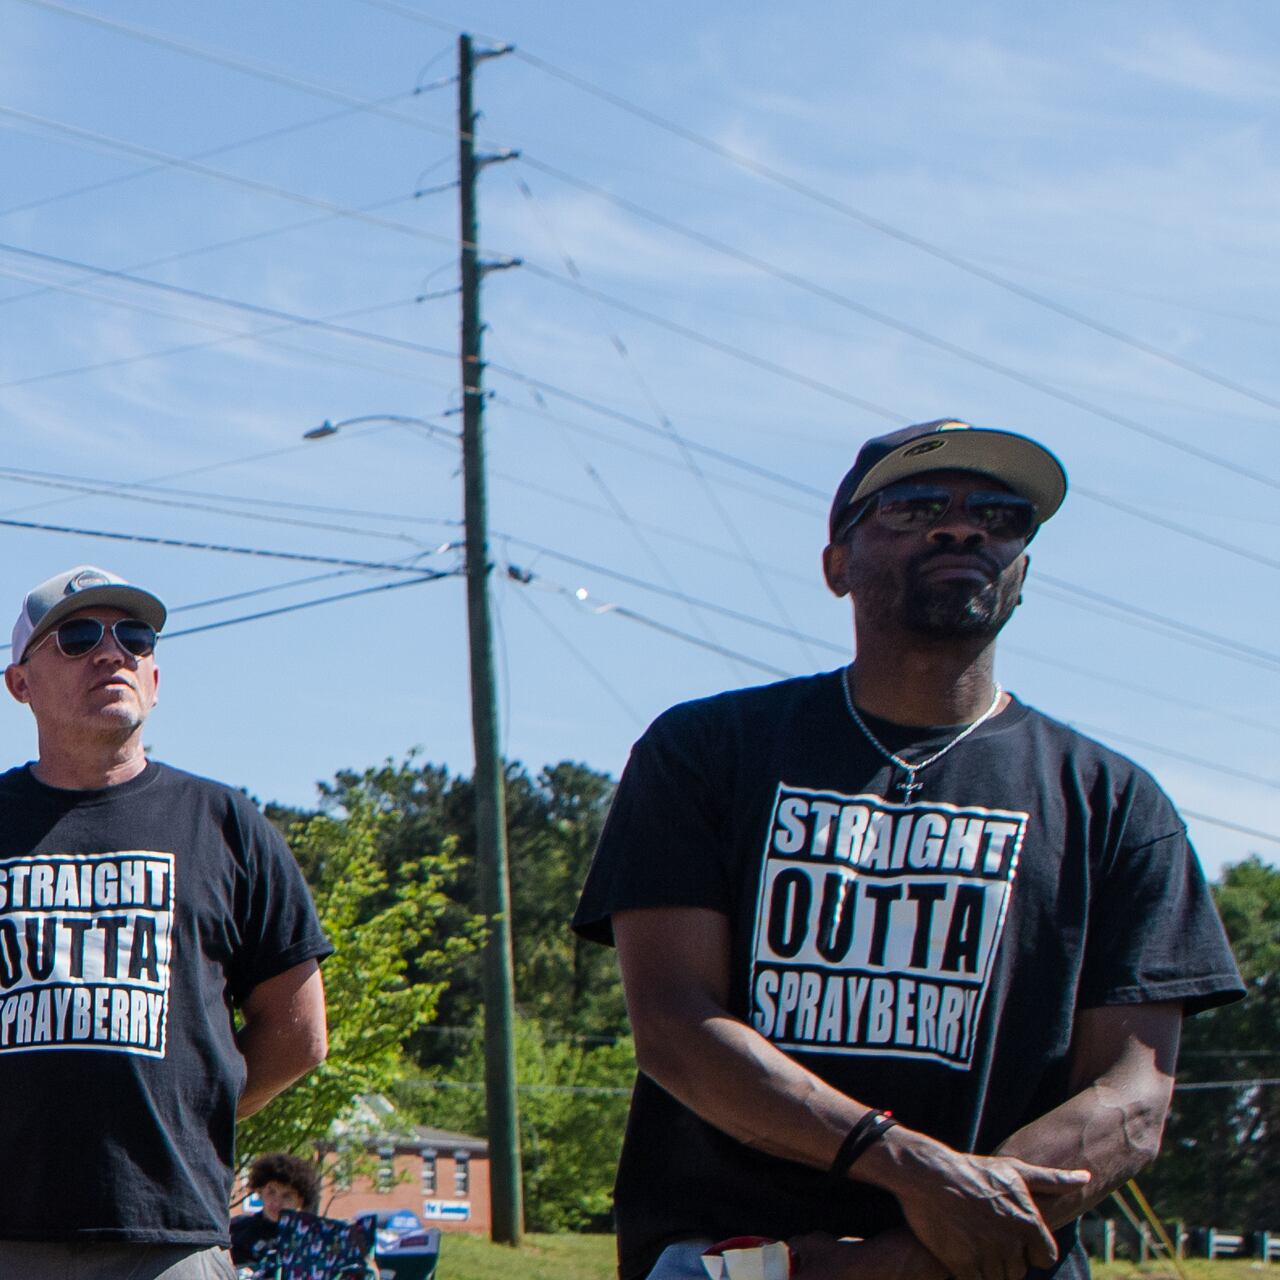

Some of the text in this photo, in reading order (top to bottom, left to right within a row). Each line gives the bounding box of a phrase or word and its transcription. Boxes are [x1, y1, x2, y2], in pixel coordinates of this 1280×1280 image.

[774, 798, 1017, 873] STRAIGHT
[768, 867, 987, 974] OUTTA
[753, 969, 978, 1058] SPRAYBERRY
